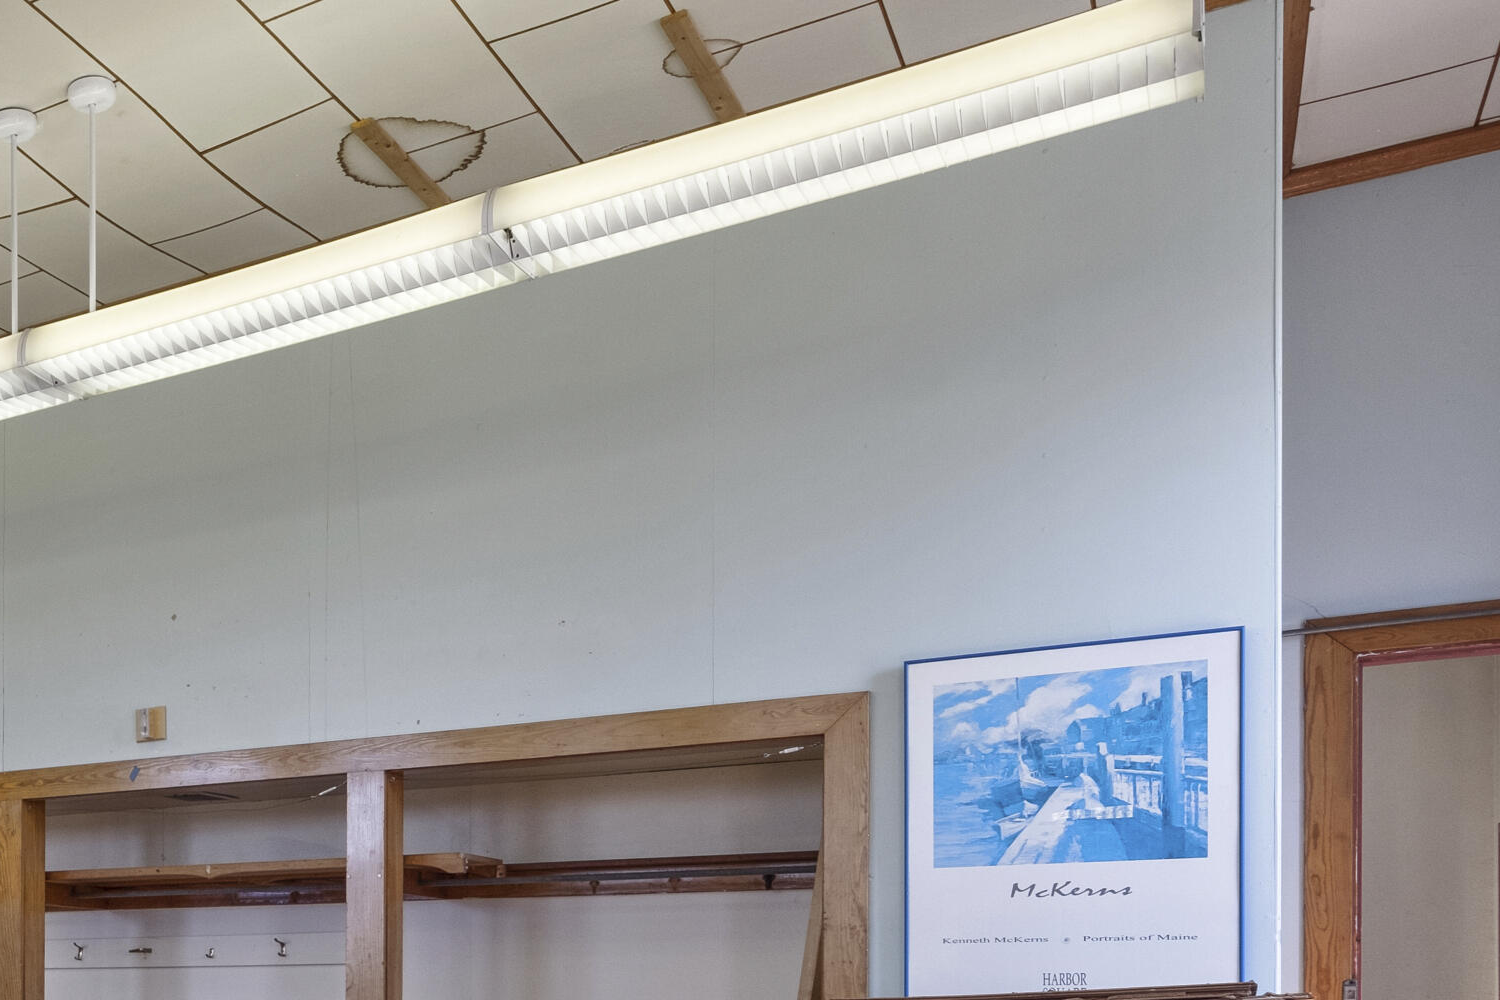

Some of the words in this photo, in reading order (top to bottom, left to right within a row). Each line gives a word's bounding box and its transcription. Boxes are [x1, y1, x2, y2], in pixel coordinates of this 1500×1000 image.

[1010, 880, 1133, 898] McKerns
[1083, 934, 1135, 942] Portraits
[1042, 972, 1087, 986] HARBOR
